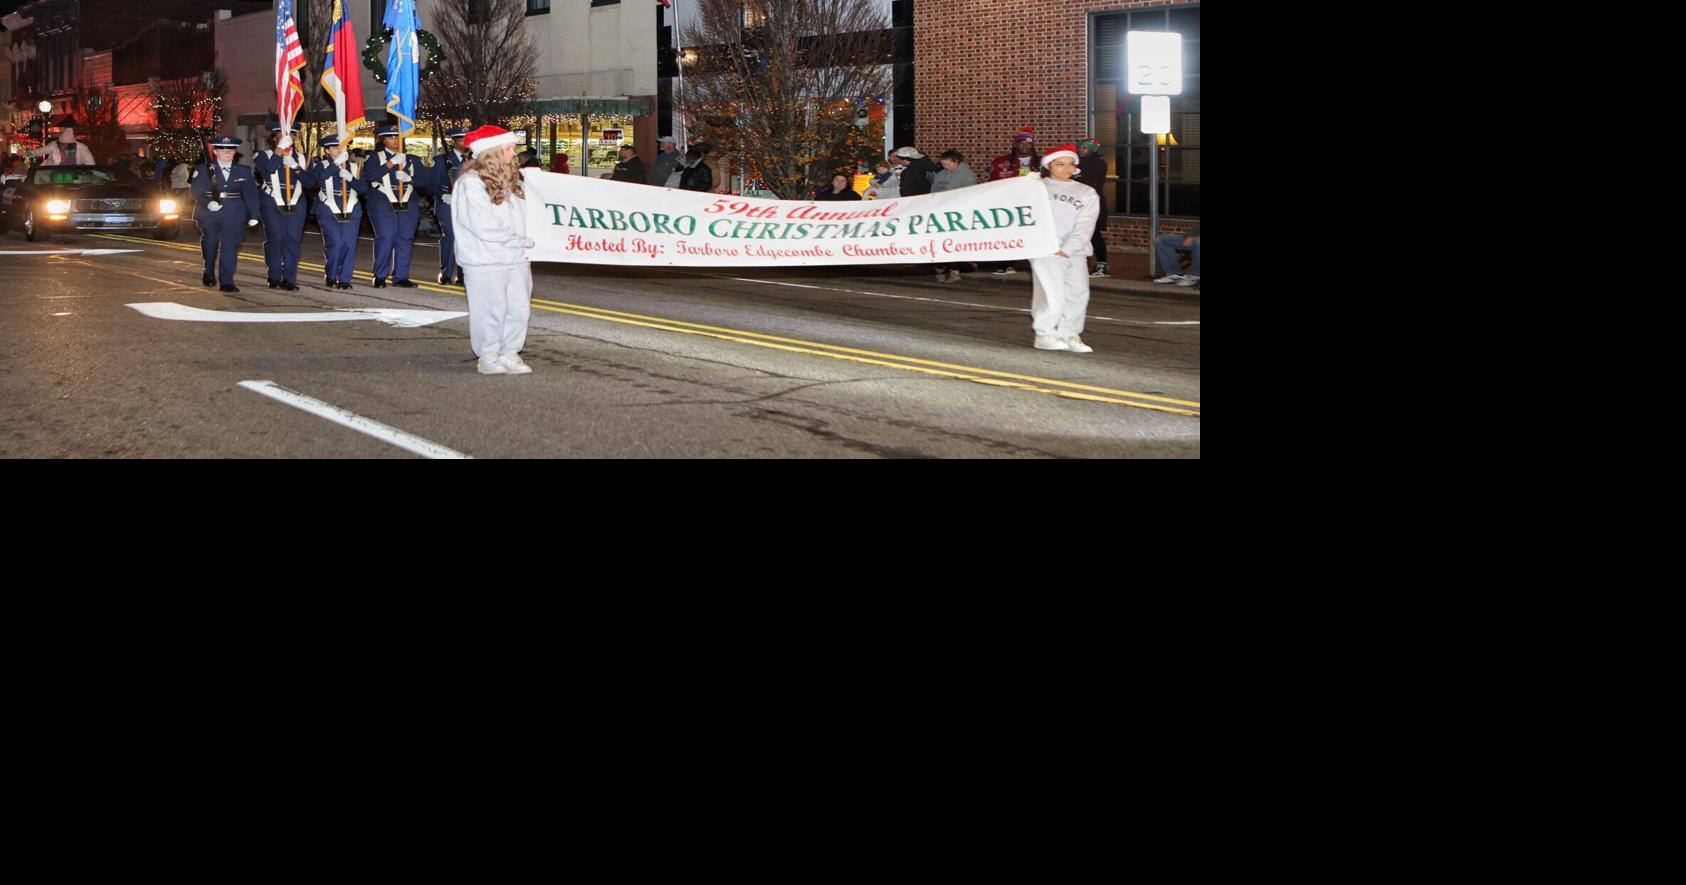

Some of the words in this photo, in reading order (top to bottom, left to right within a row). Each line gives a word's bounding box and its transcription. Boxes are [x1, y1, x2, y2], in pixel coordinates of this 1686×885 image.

[703, 199, 779, 219] 59th
[786, 202, 899, 221] Annual
[1054, 193, 1085, 210] FORCE
[545, 203, 697, 236] TARBORO
[708, 218, 900, 240] CHRISTMAS
[907, 205, 1037, 236] PARADE
[565, 234, 626, 253] Hosted
[631, 238, 665, 258] By:
[676, 240, 739, 257] Tarboro
[744, 244, 834, 260] Edgecombe
[842, 241, 913, 257] Chamber
[919, 239, 936, 258] of
[942, 238, 1025, 253] Commerce
